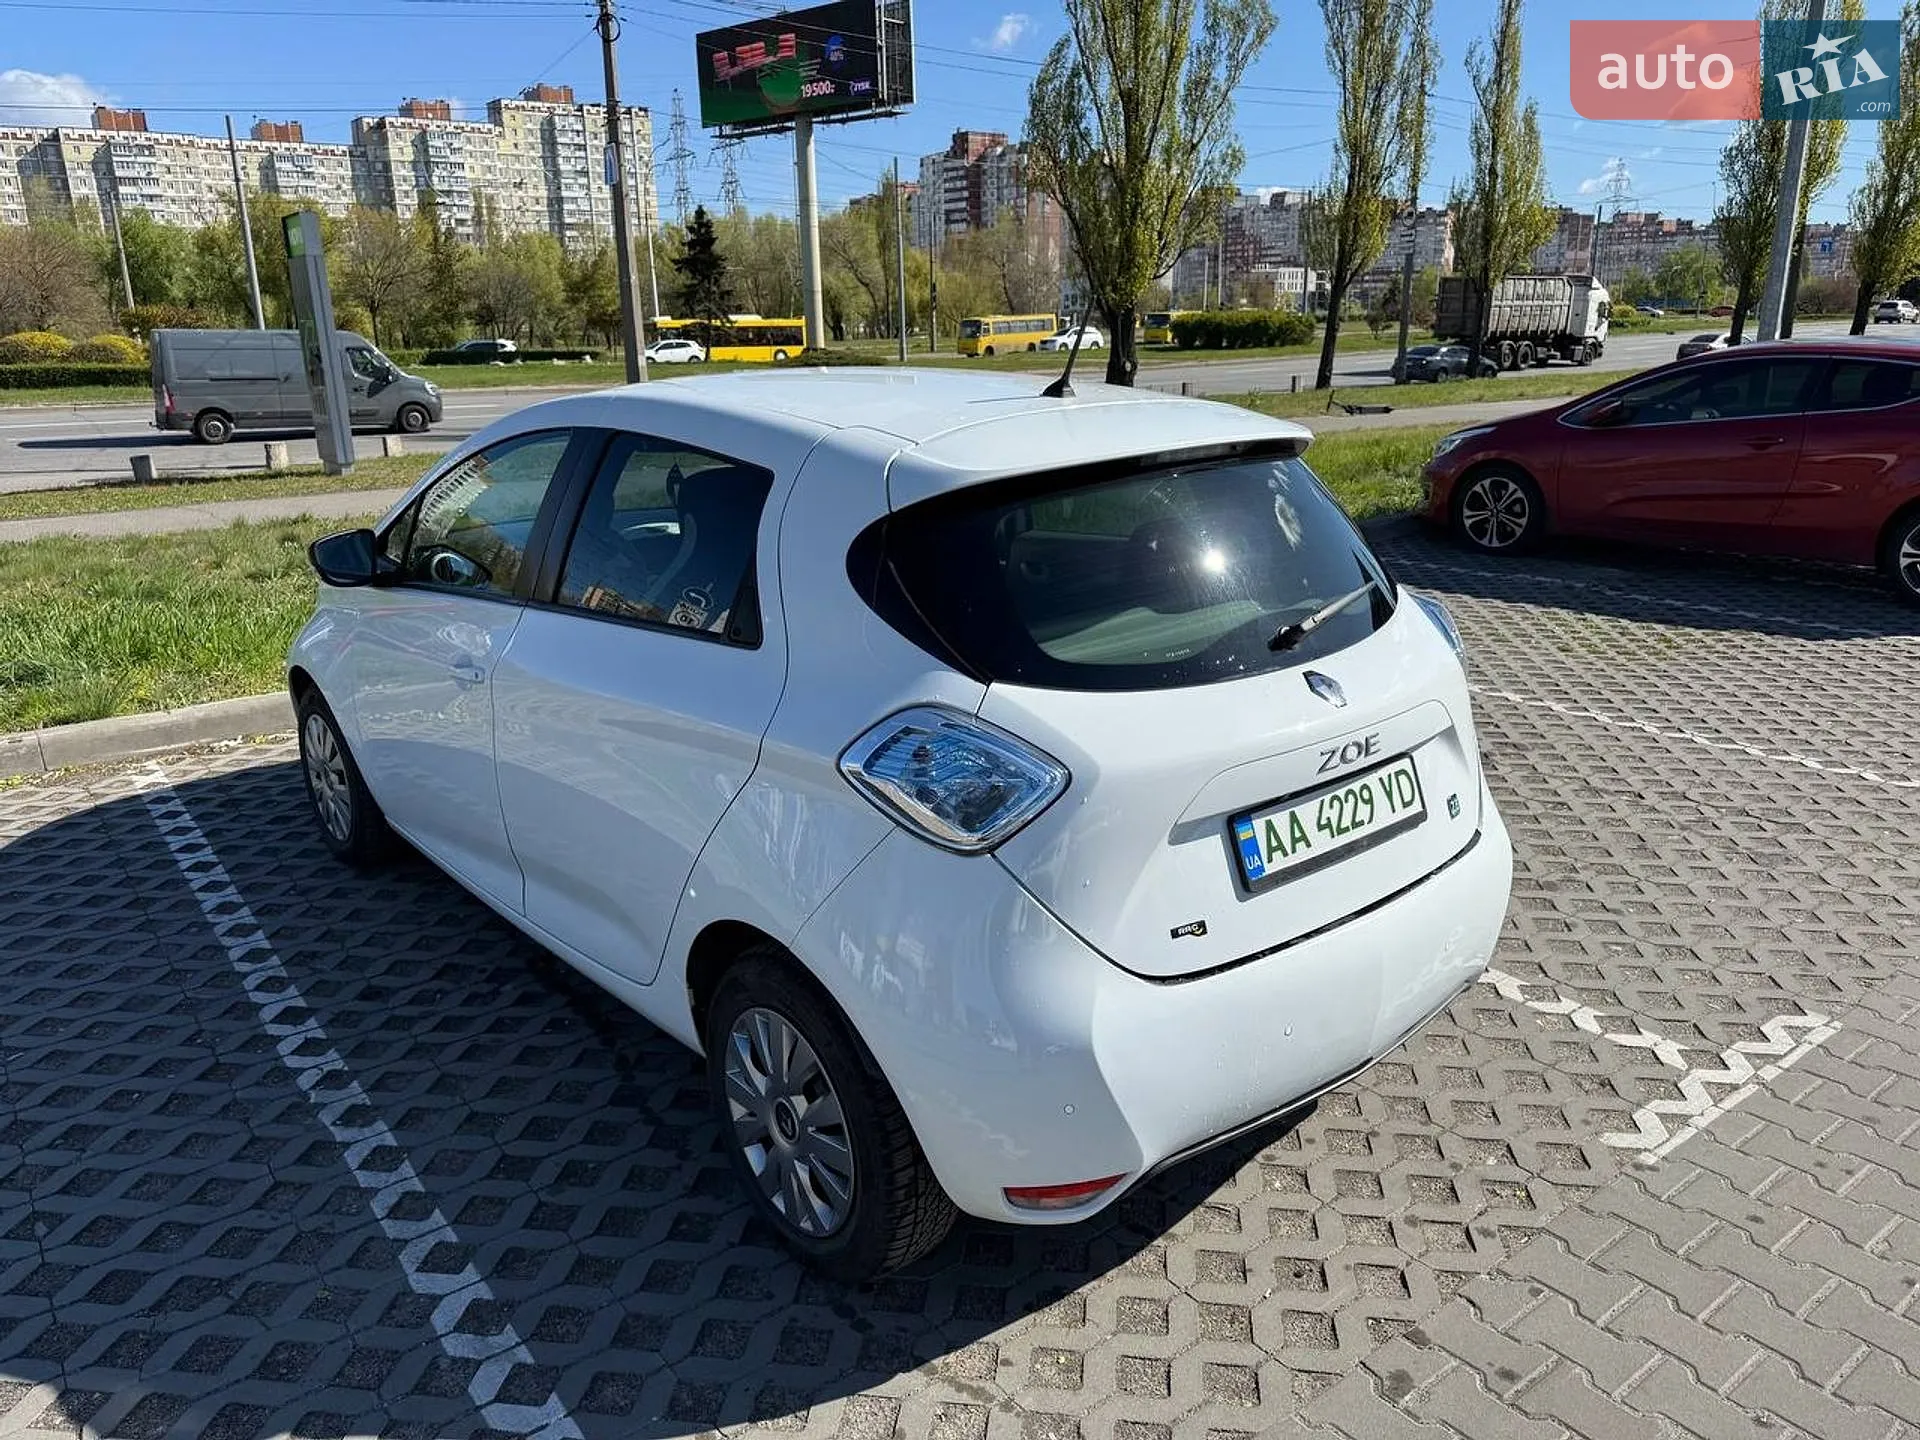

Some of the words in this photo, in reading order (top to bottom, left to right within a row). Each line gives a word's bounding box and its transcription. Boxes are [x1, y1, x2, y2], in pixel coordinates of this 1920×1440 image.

[1316, 733, 1380, 775] ZOE
[1264, 811, 1312, 864] AA
[1316, 782, 1375, 839] 4229
[1378, 768, 1416, 814] YD
[1244, 855, 1262, 870] UA
